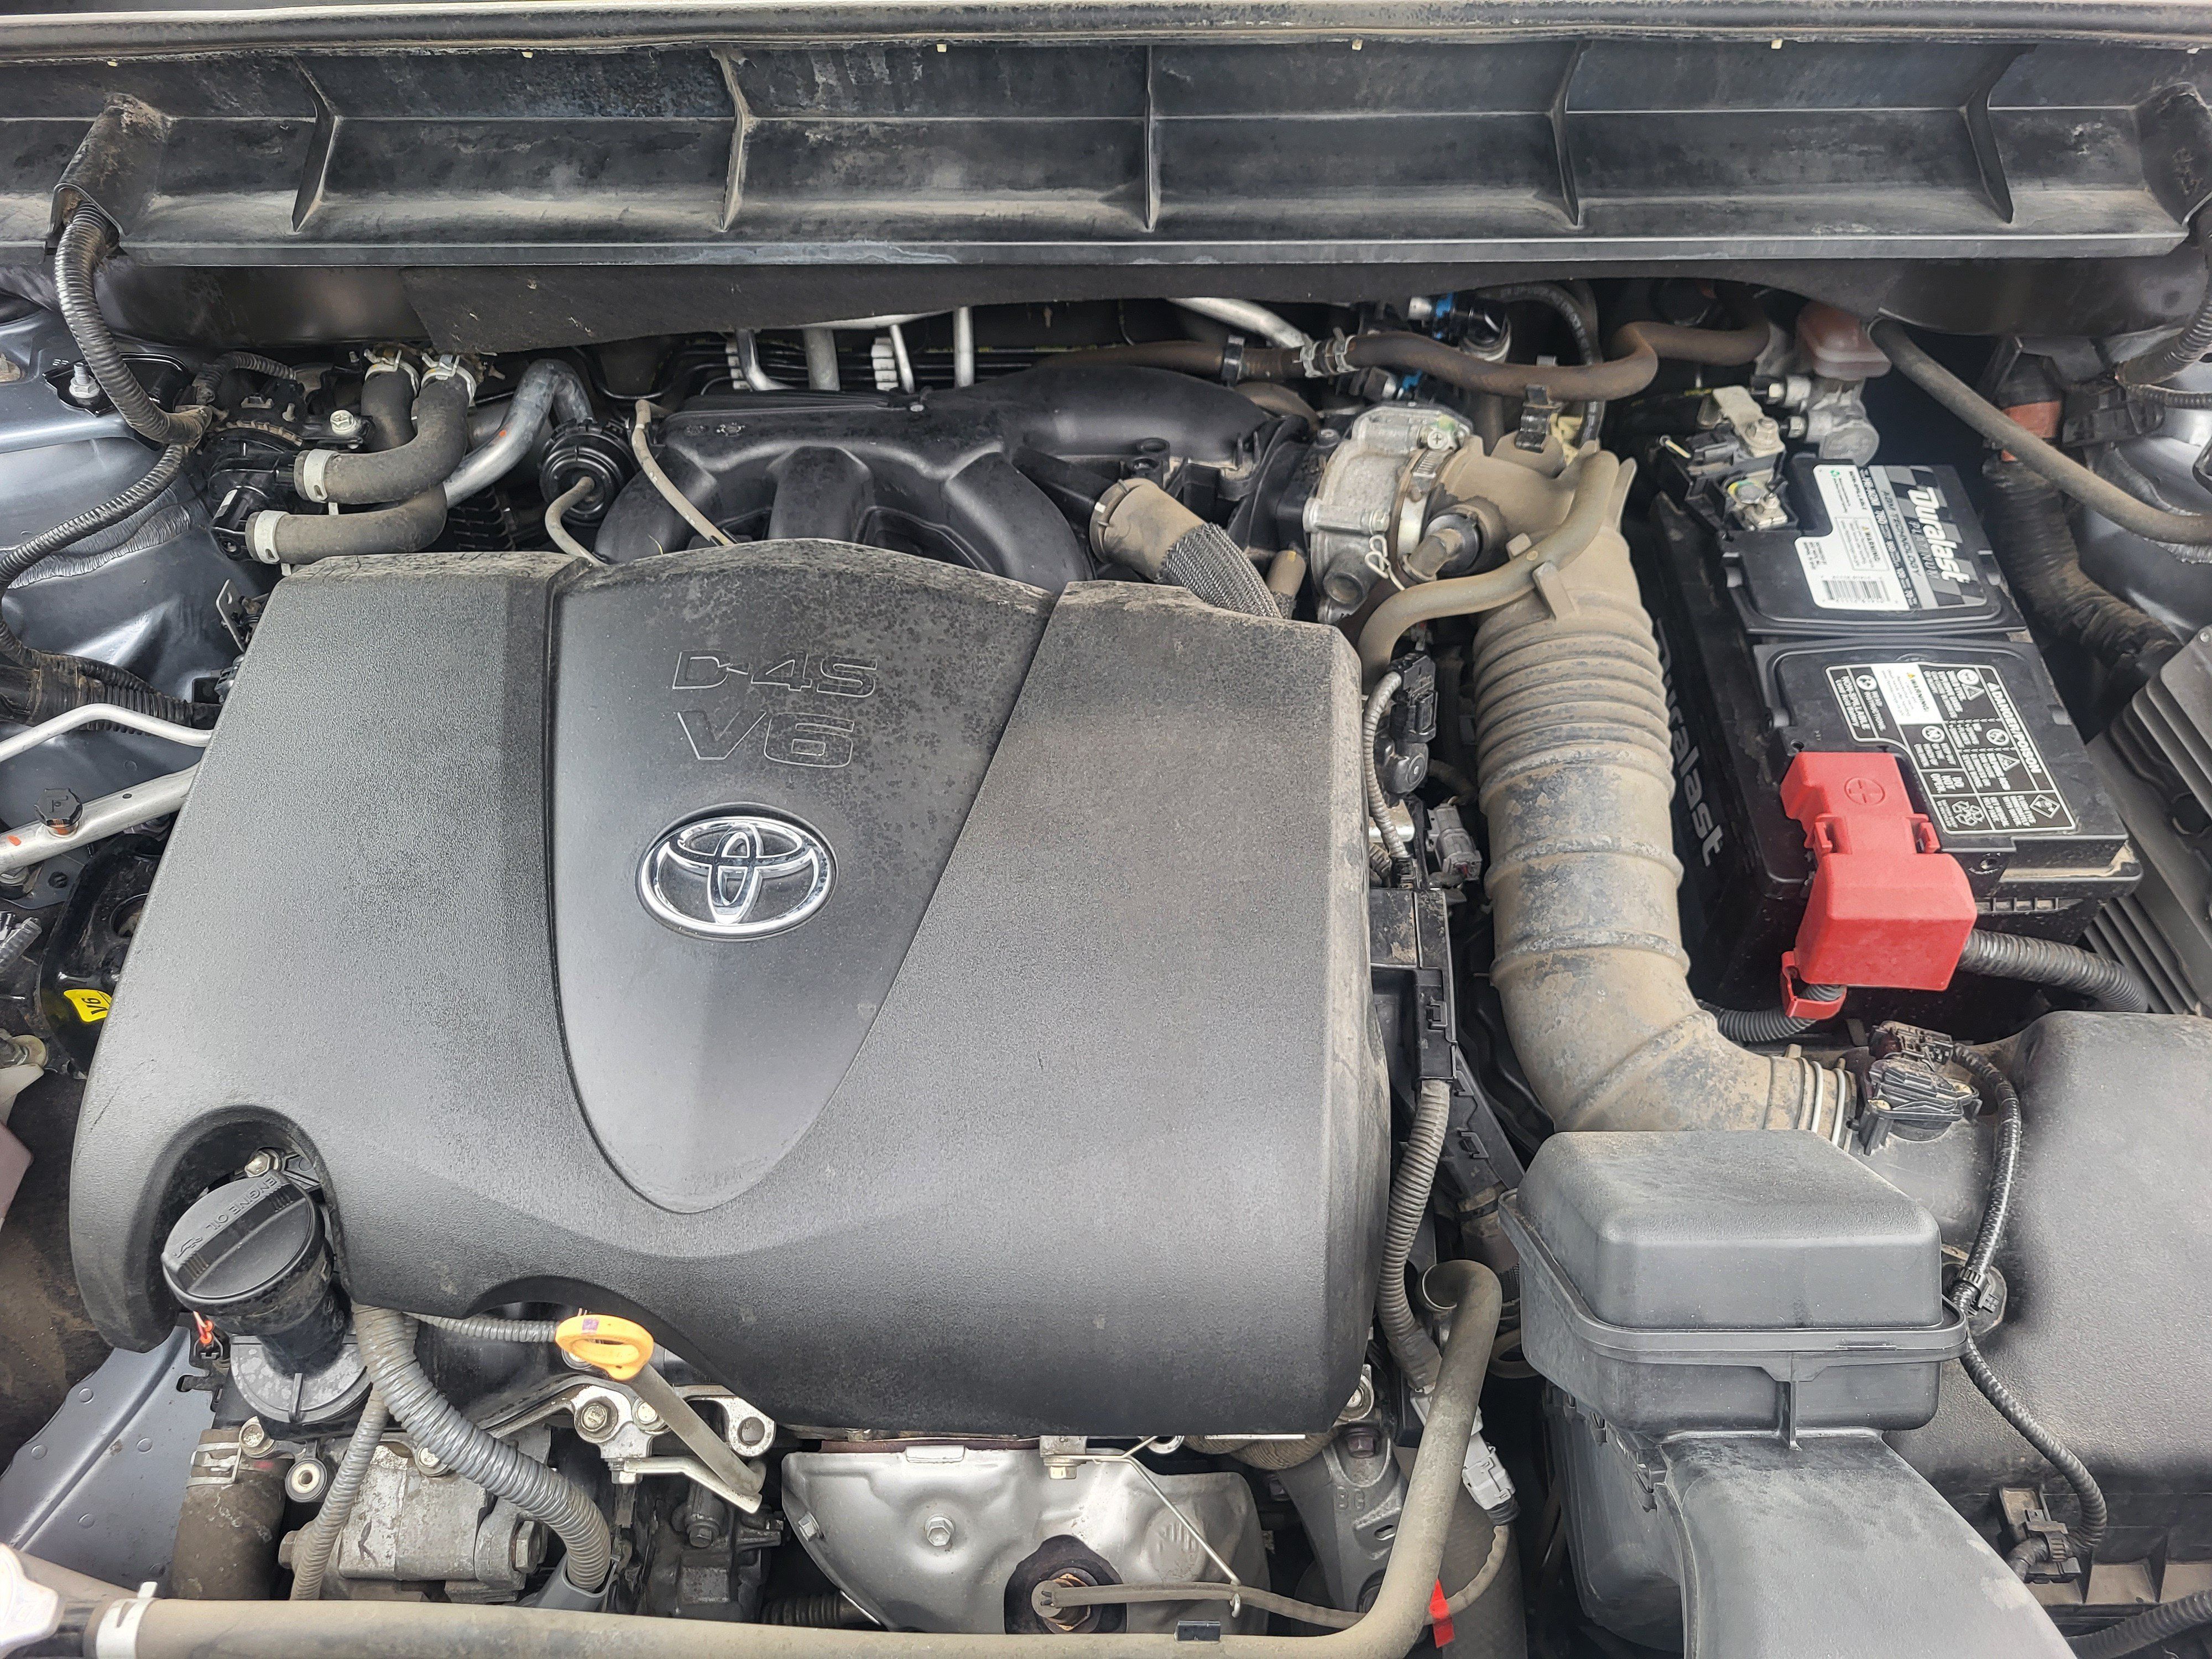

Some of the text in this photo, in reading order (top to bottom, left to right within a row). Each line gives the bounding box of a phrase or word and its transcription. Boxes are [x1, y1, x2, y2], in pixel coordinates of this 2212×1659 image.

[1882, 491, 1895, 510] AGM
[1891, 515, 1921, 576] TECHNOLOGY
[1907, 487, 1971, 584] Duralast
[1909, 520, 1940, 580] PLATINUM
[672, 650, 878, 698] D-4S
[677, 710, 855, 768] V6
[1991, 690, 2042, 773] DANGER/POISON
[81, 997, 109, 1015] V6
[205, 1177, 278, 1231] ENGINE OIL
